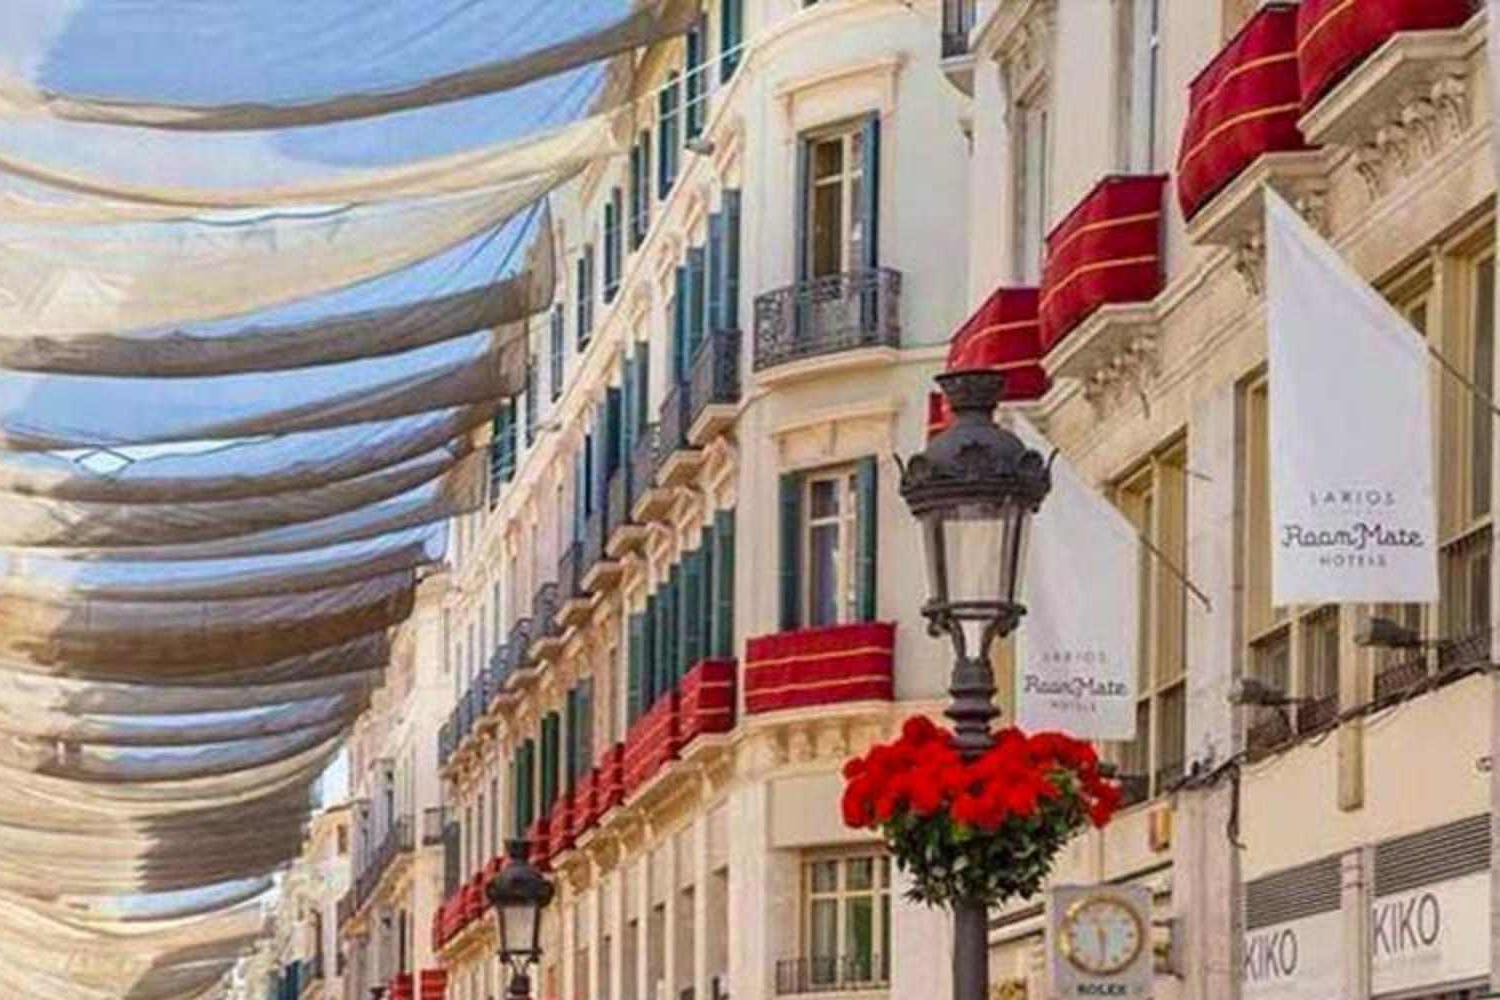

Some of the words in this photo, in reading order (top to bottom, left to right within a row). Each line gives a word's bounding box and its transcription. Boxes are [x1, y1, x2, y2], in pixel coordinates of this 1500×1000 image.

[1310, 490, 1395, 507] LARIOS
[1373, 893, 1440, 956] KIKO
[1244, 929, 1297, 980] KIKO
[1077, 983, 1127, 996] ROLEX
